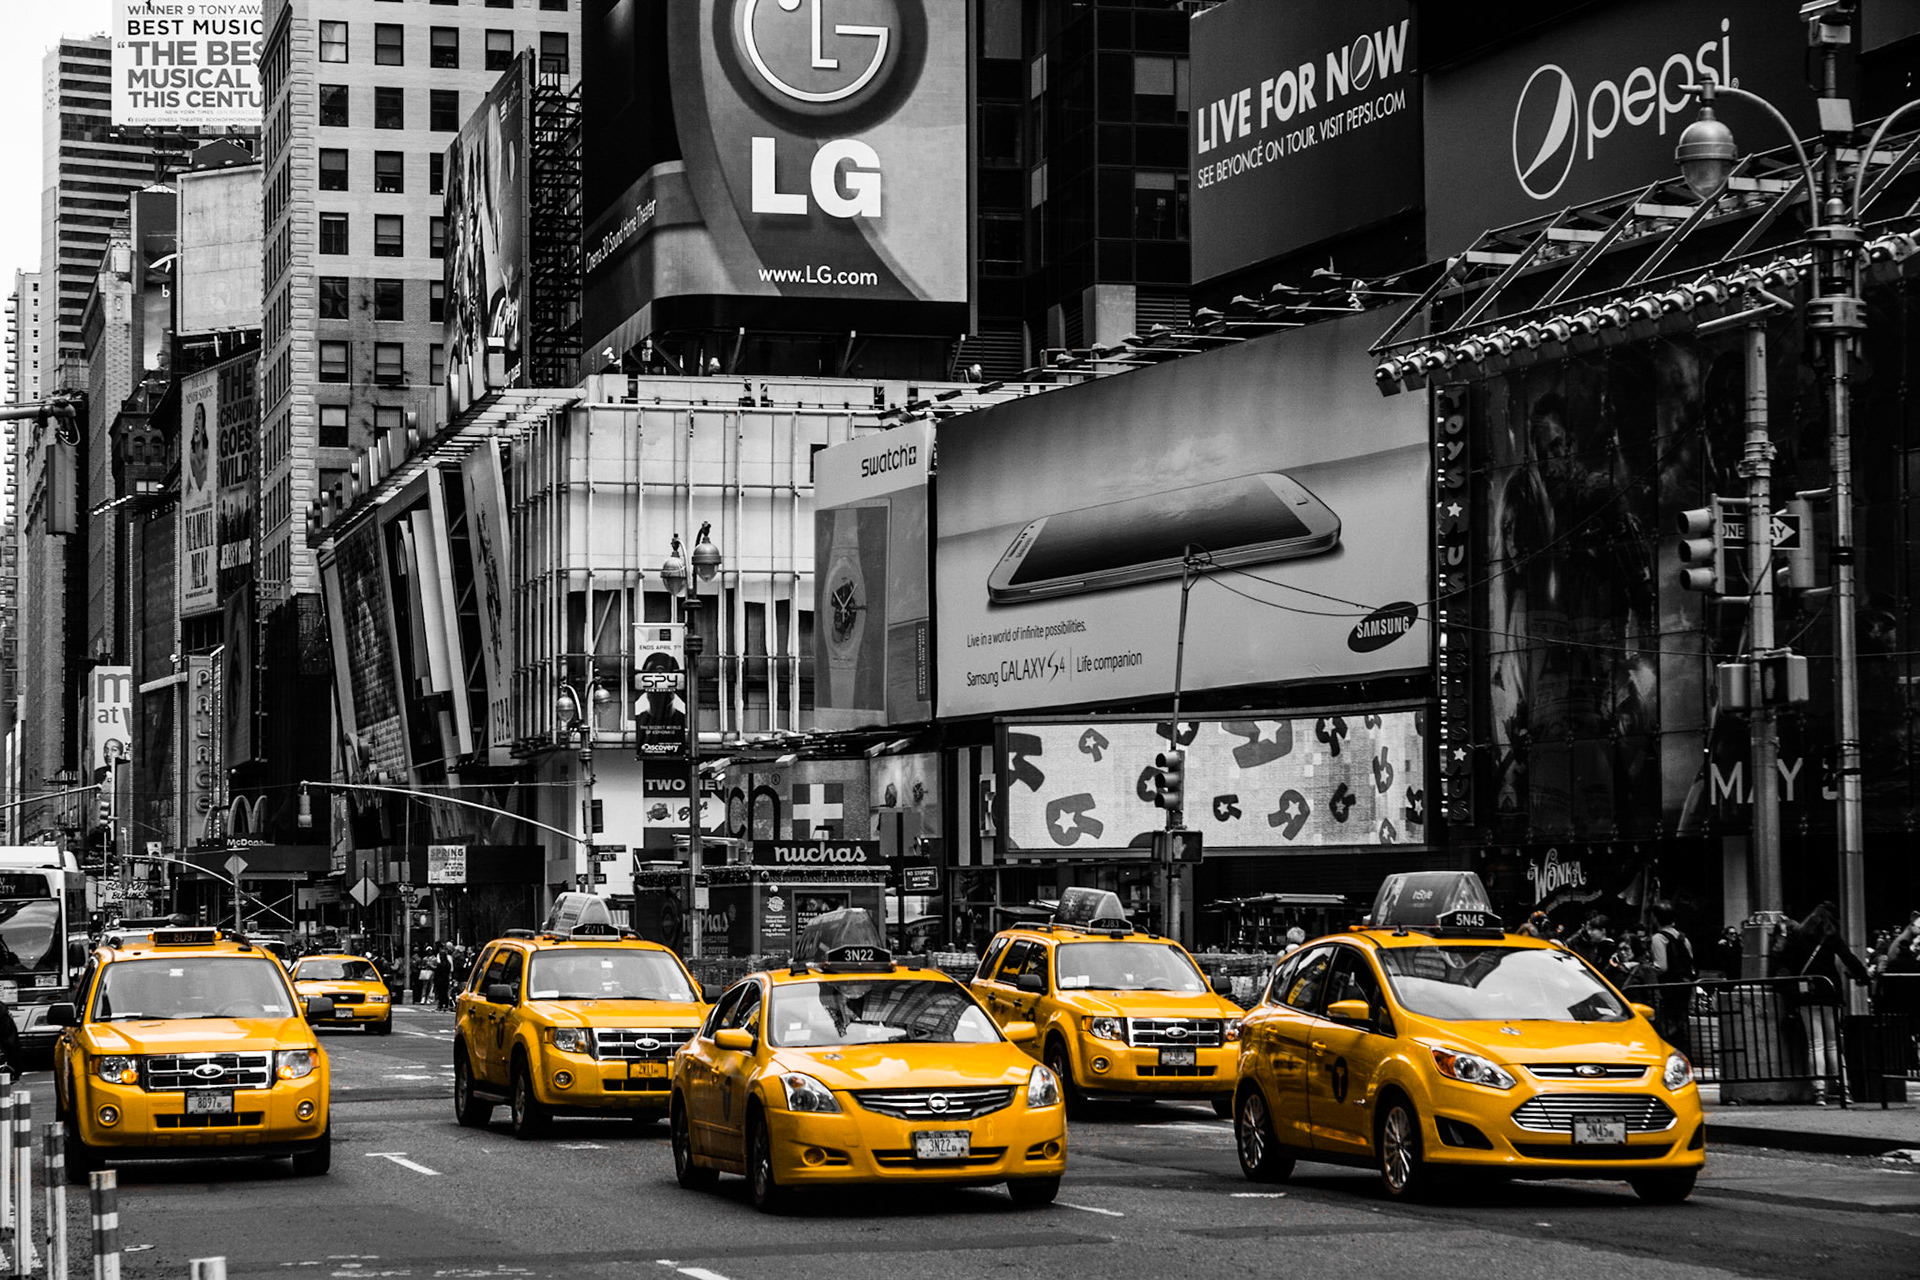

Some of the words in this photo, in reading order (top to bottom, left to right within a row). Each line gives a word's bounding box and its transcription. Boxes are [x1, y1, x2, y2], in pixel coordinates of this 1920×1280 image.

[128, 4, 183, 15] WINNER
[187, 4, 195, 15] 9
[199, 4, 236, 15] TONY
[238, 4, 262, 15] AW
[128, 20, 184, 36] BEST
[128, 68, 251, 89] MUSICAL
[128, 90, 180, 108] THIS
[1587, 17, 1732, 161] pepsi
[1197, 88, 1251, 154] LIVE
[1260, 62, 1317, 129] FOR
[1198, 166, 1214, 189] SEE
[1216, 140, 1264, 182] BEYONCÉ
[1265, 137, 1284, 162] ON
[1286, 128, 1318, 154] TOUR.
[1320, 112, 1344, 142] VISIT
[1346, 88, 1406, 132] PEPSI.COM
[751, 136, 882, 218] LG
[758, 264, 878, 286] www.LG.com
[220, 359, 253, 404] THE
[220, 399, 252, 428] CROWD
[220, 422, 252, 458] GOES
[861, 444, 908, 478] swatch
[967, 634, 980, 648] Live
[981, 632, 987, 645] in
[988, 634, 992, 644] a
[993, 629, 1011, 643] world
[1012, 627, 1020, 640] of
[1020, 625, 1044, 640] infinite
[1045, 619, 1087, 640] possibilities.
[1356, 616, 1409, 639] SAMSUNG
[967, 671, 998, 687] Samsung
[1001, 656, 1046, 682] GALAXY
[1077, 655, 1092, 672] Life
[1094, 650, 1142, 672] companion
[642, 675, 678, 688] SPY
[97, 706, 119, 724] at
[643, 743, 679, 752] Discovery
[645, 778, 686, 791] TWO
[430, 848, 464, 857] SPRING
[774, 842, 867, 862] nuchas
[584, 925, 605, 934] 2V11
[1456, 914, 1484, 926] 5N45
[174, 933, 198, 942] 8D97
[845, 950, 874, 961] 3N22
